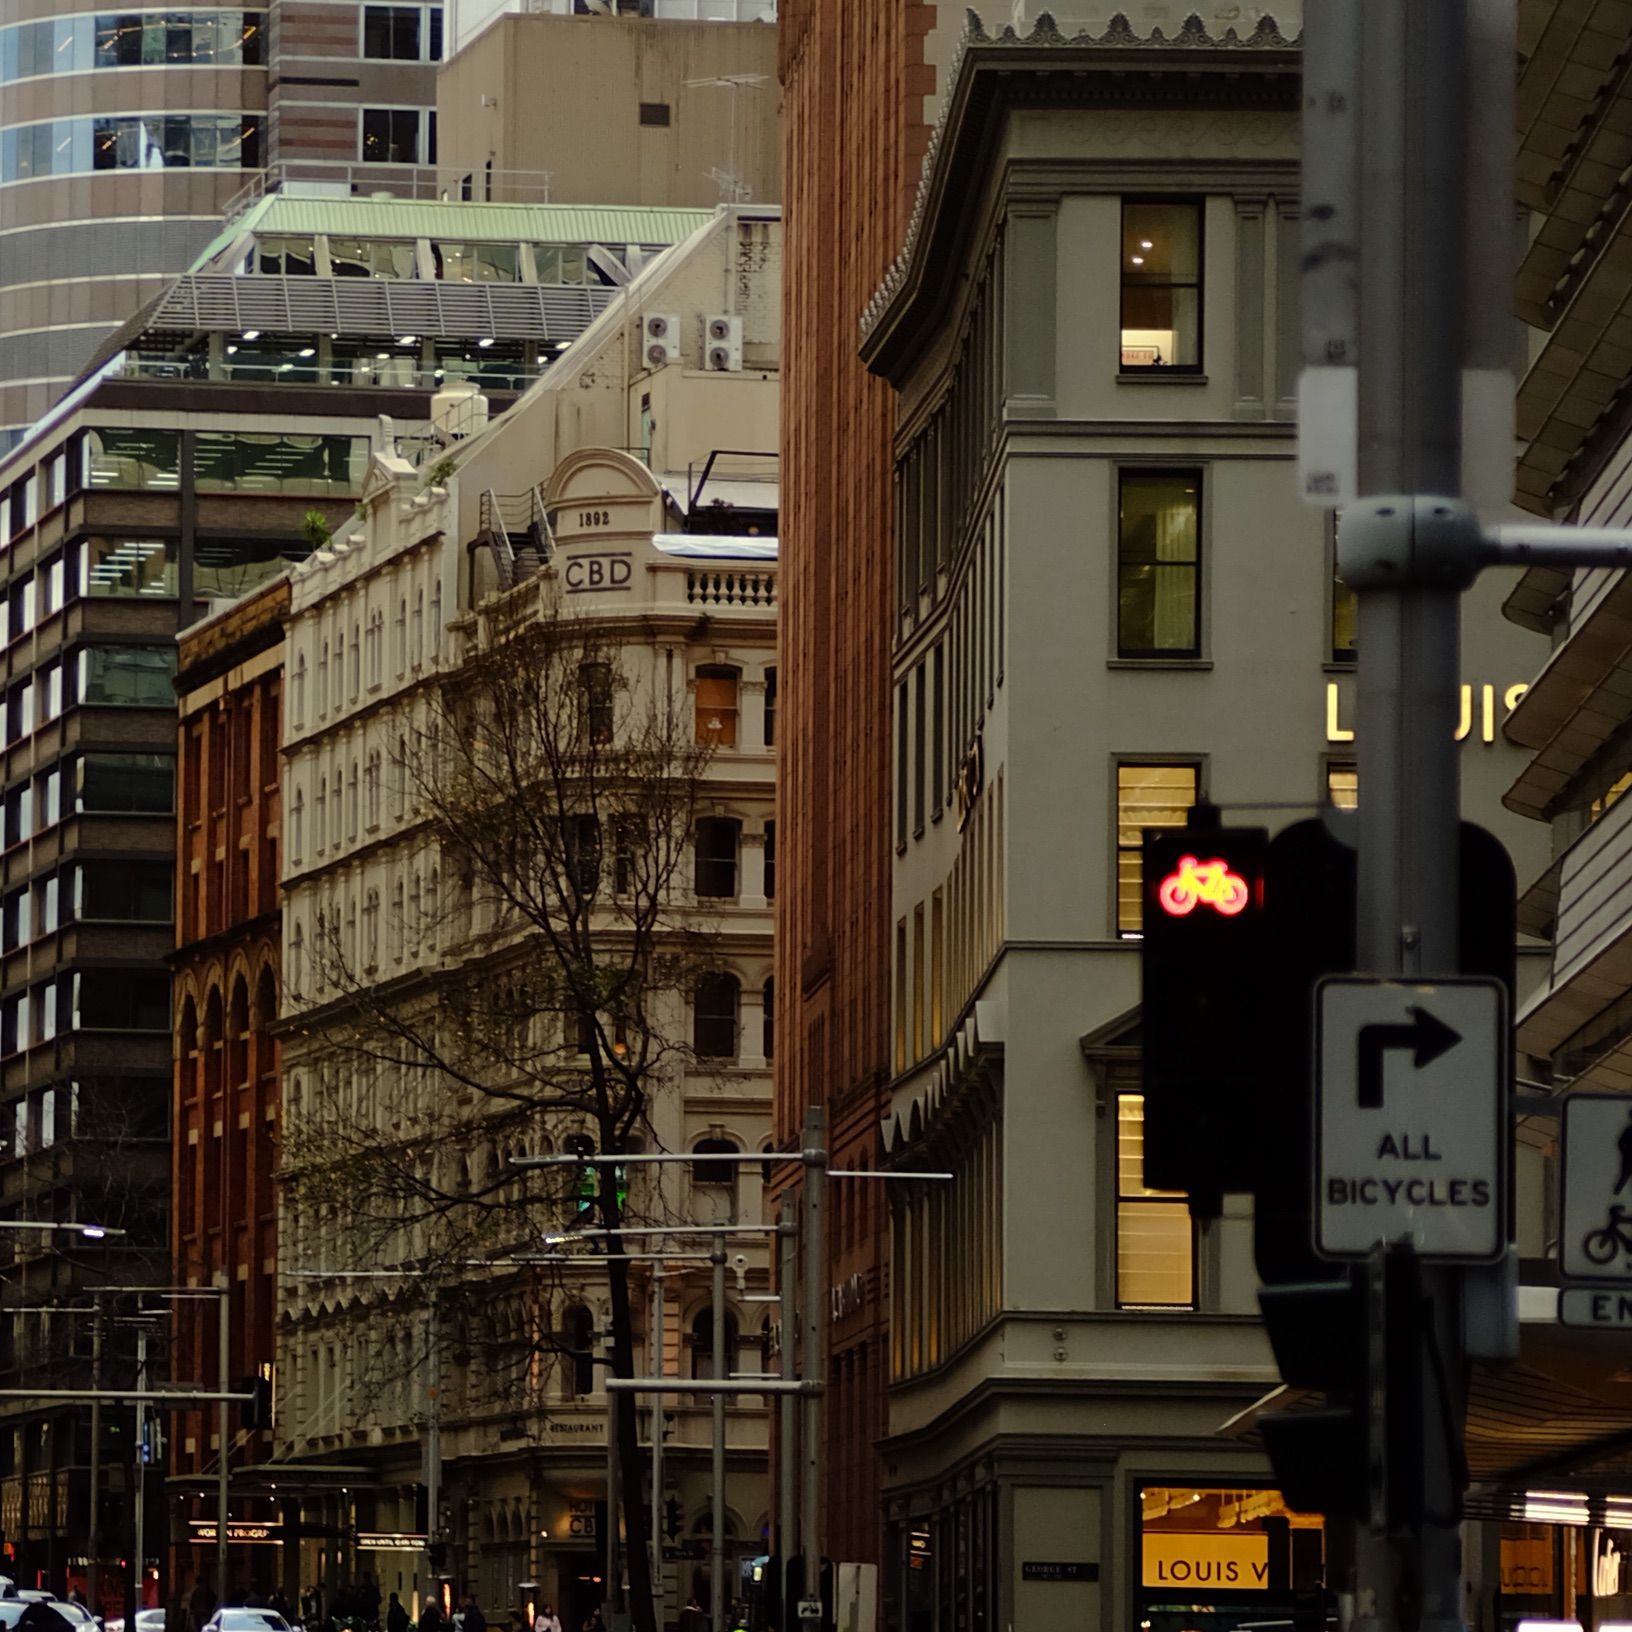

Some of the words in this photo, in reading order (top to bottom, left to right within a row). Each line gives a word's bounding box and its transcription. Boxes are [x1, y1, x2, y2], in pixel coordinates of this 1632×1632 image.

[579, 511, 610, 527] 1892
[566, 559, 632, 587] CBD
[1377, 1133, 1442, 1161] ALL
[1328, 1178, 1491, 1207] BICYCLES
[569, 1518, 594, 1534] CB
[1158, 1559, 1239, 1582] LOUIS
